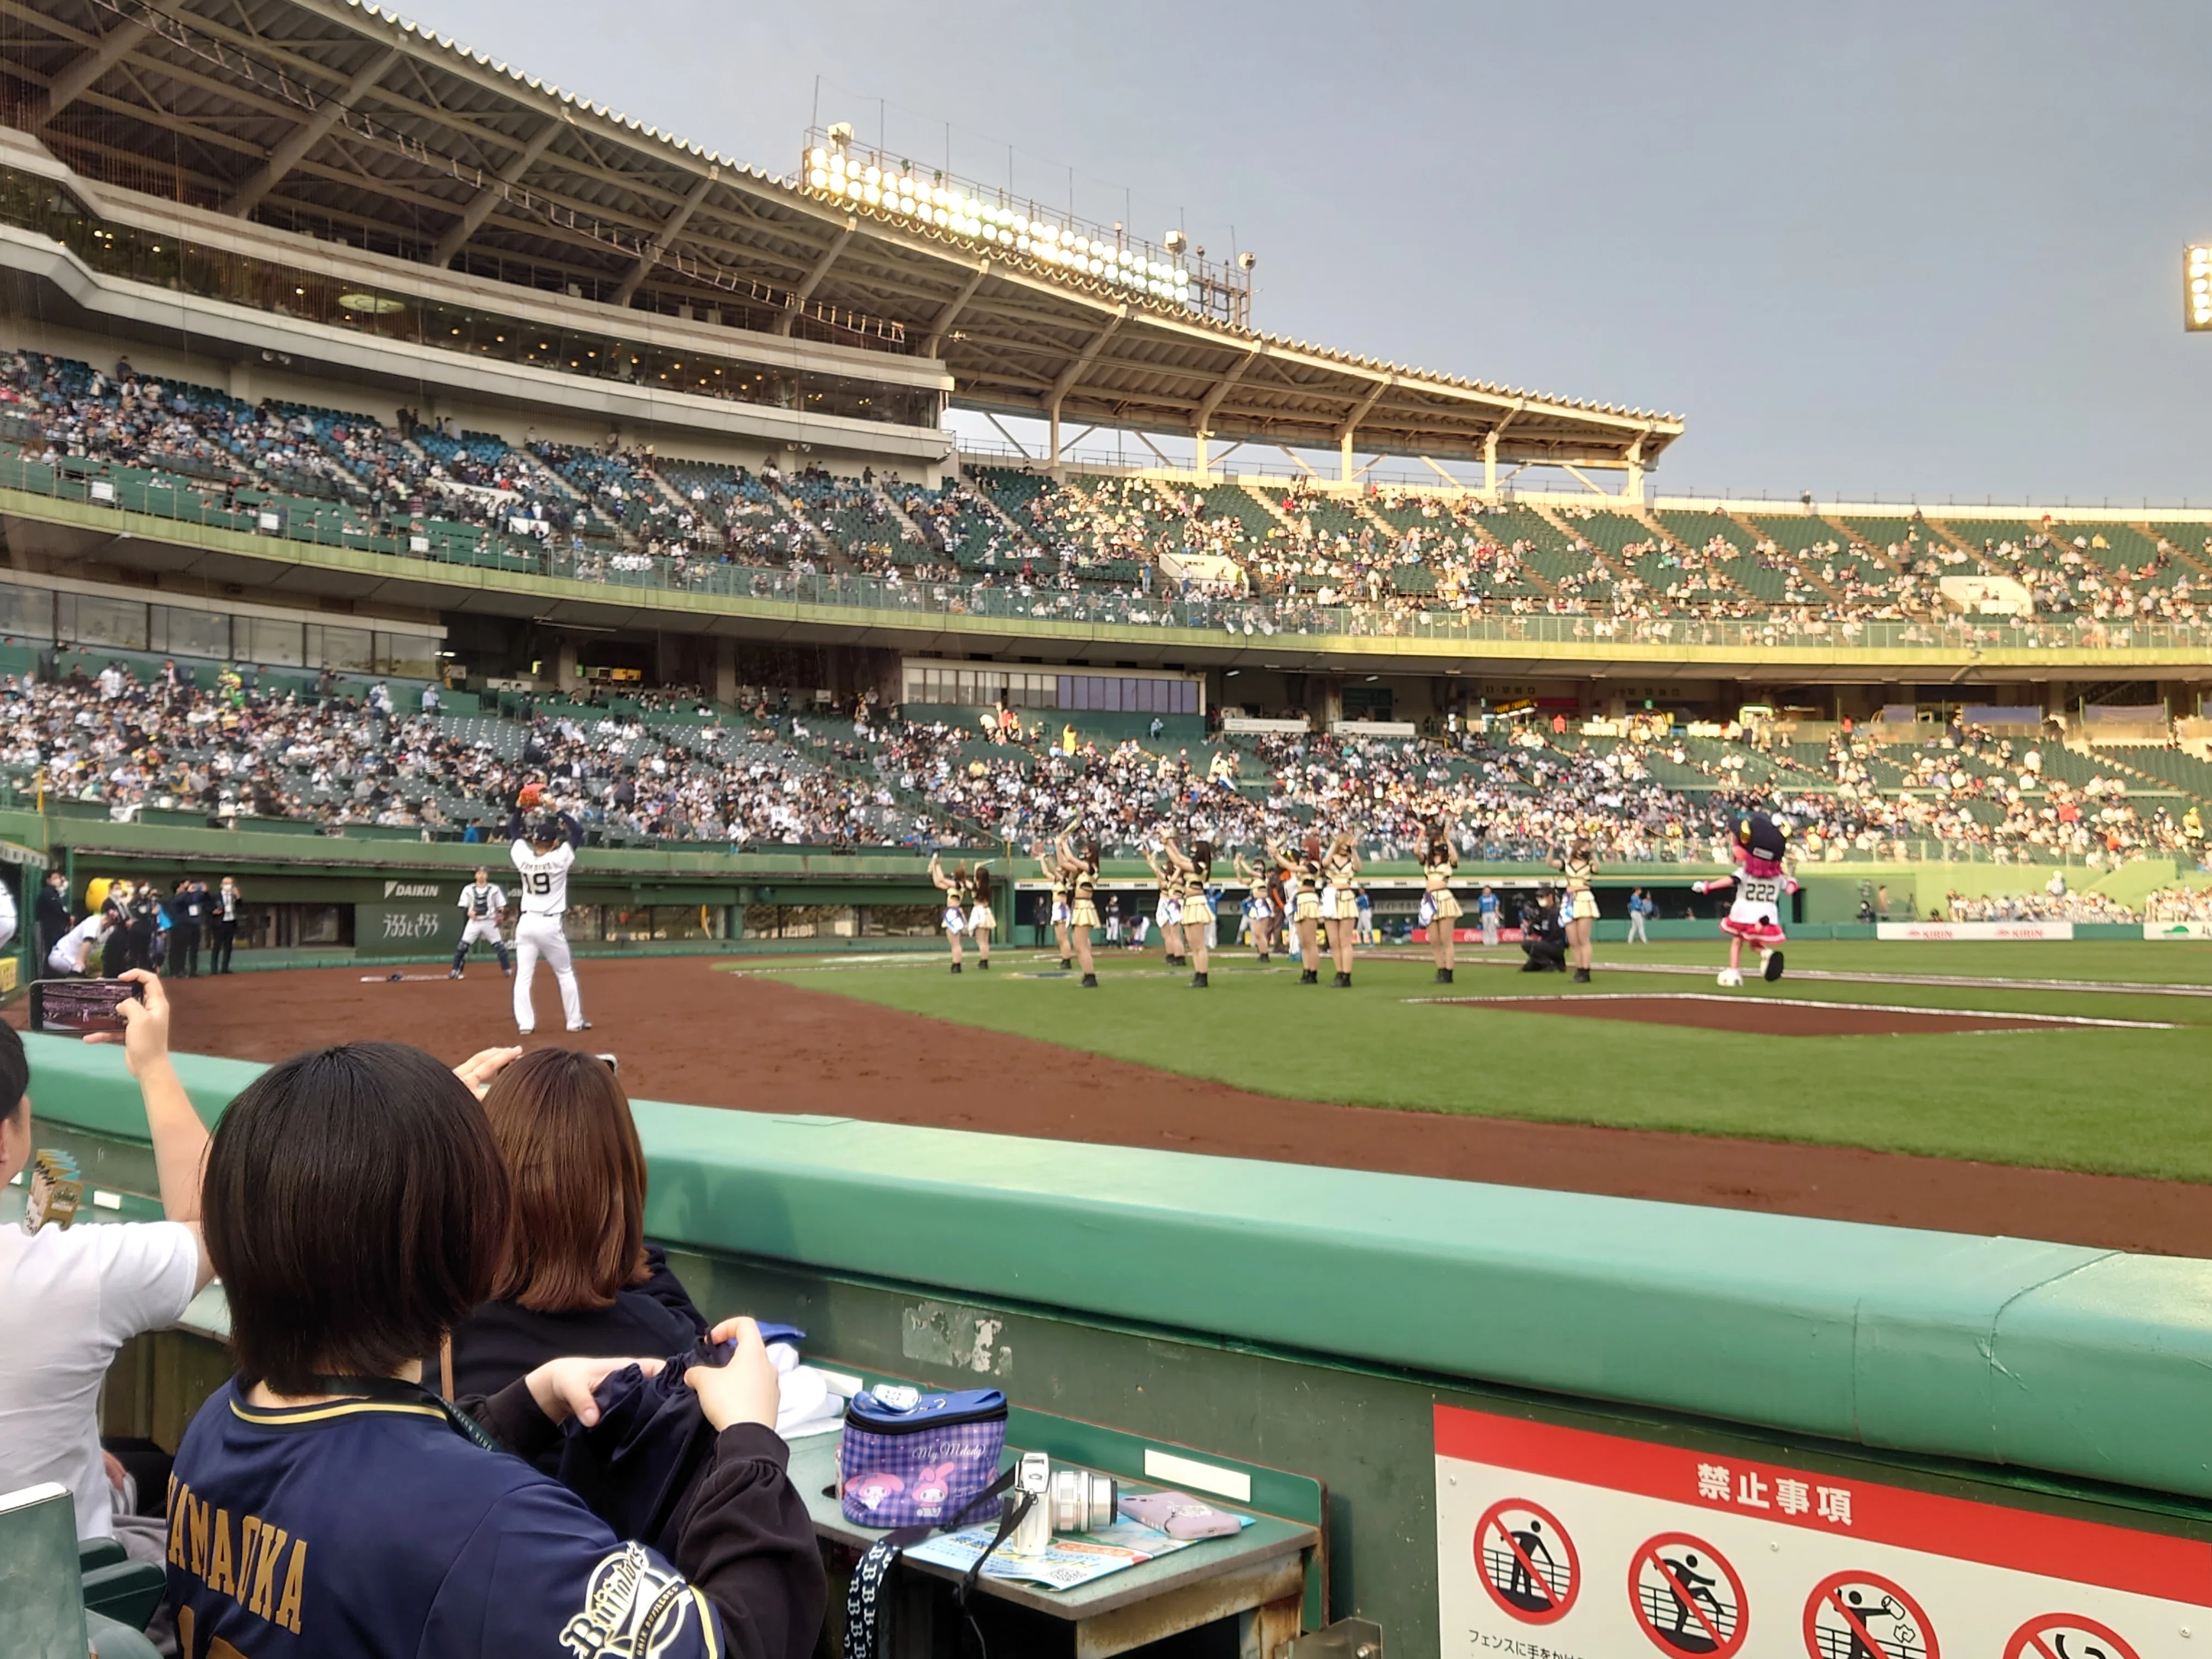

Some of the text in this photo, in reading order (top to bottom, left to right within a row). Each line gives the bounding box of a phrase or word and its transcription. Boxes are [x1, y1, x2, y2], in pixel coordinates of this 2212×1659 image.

[394, 884, 439, 897] DAIKIN
[523, 872, 551, 895] 19
[1746, 883, 1775, 902] 222
[382, 912, 438, 938] うるるとさらら
[1922, 930, 1953, 940] KIRIN
[2012, 929, 2043, 939] KIRIN
[912, 1442, 986, 1464] My Melody
[1697, 1462, 1852, 1526] 禁止事項
[1469, 1629, 1585, 1659] フェンスに手をか
